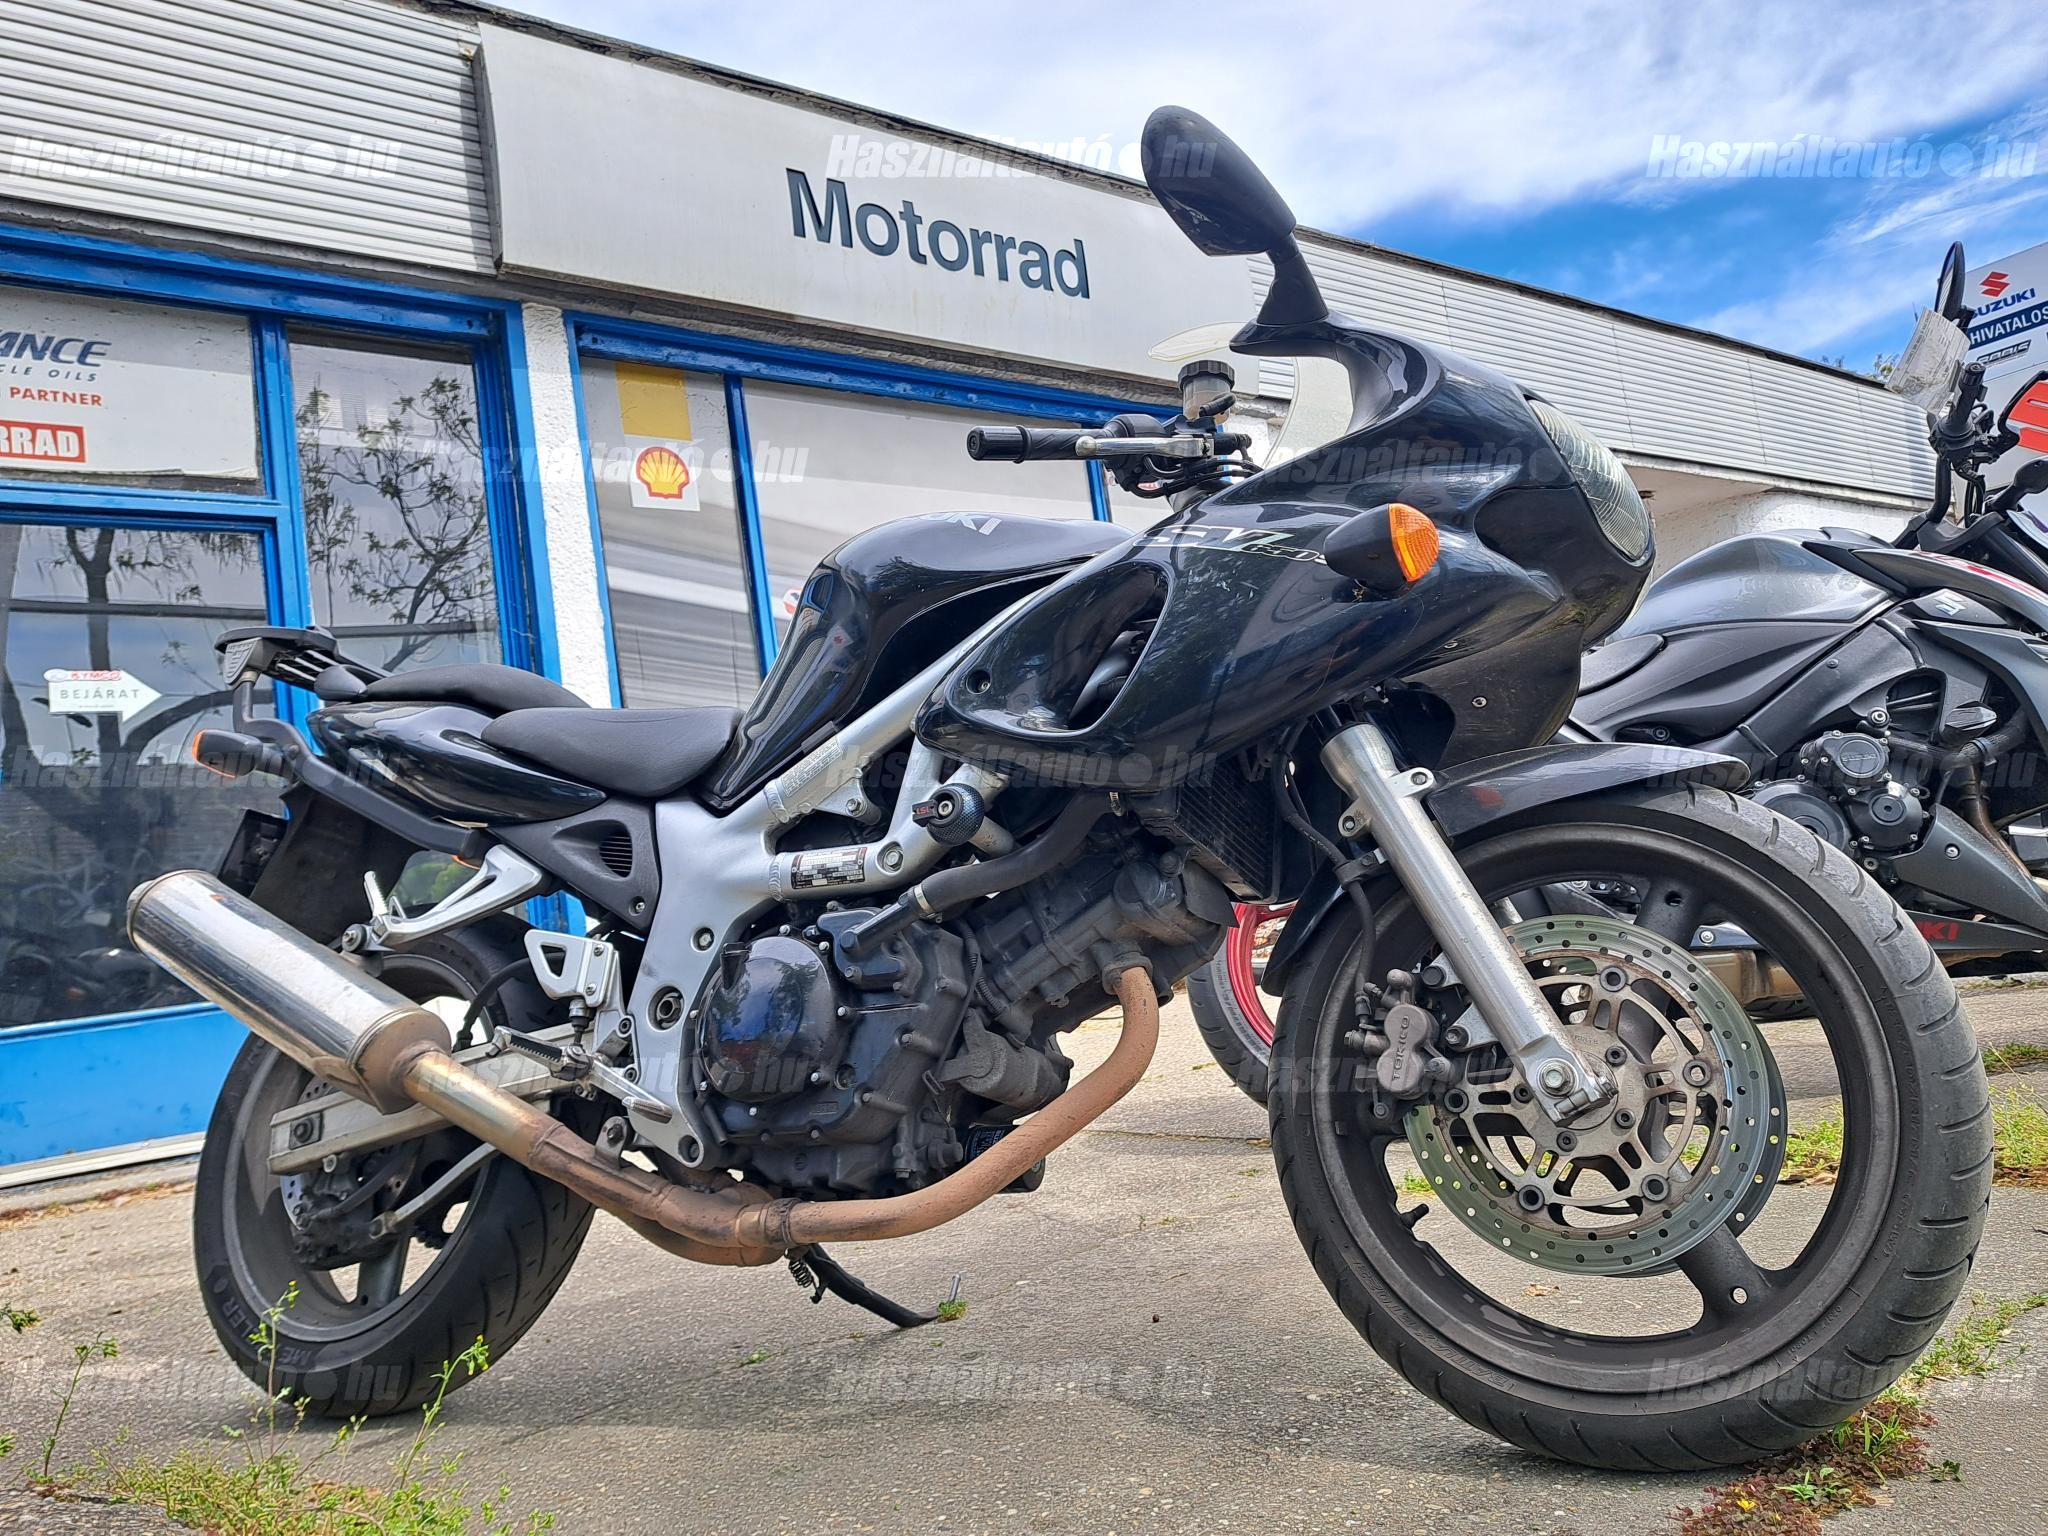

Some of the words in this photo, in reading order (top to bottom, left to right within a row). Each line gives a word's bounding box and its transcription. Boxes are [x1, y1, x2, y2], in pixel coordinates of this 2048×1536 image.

[785, 167, 1090, 299] Motorrad
[0, 330, 112, 367] ANCE
[48, 369, 97, 382] OILS
[9, 386, 103, 406] PARTNER
[59, 687, 140, 700] BEJÁRAT
